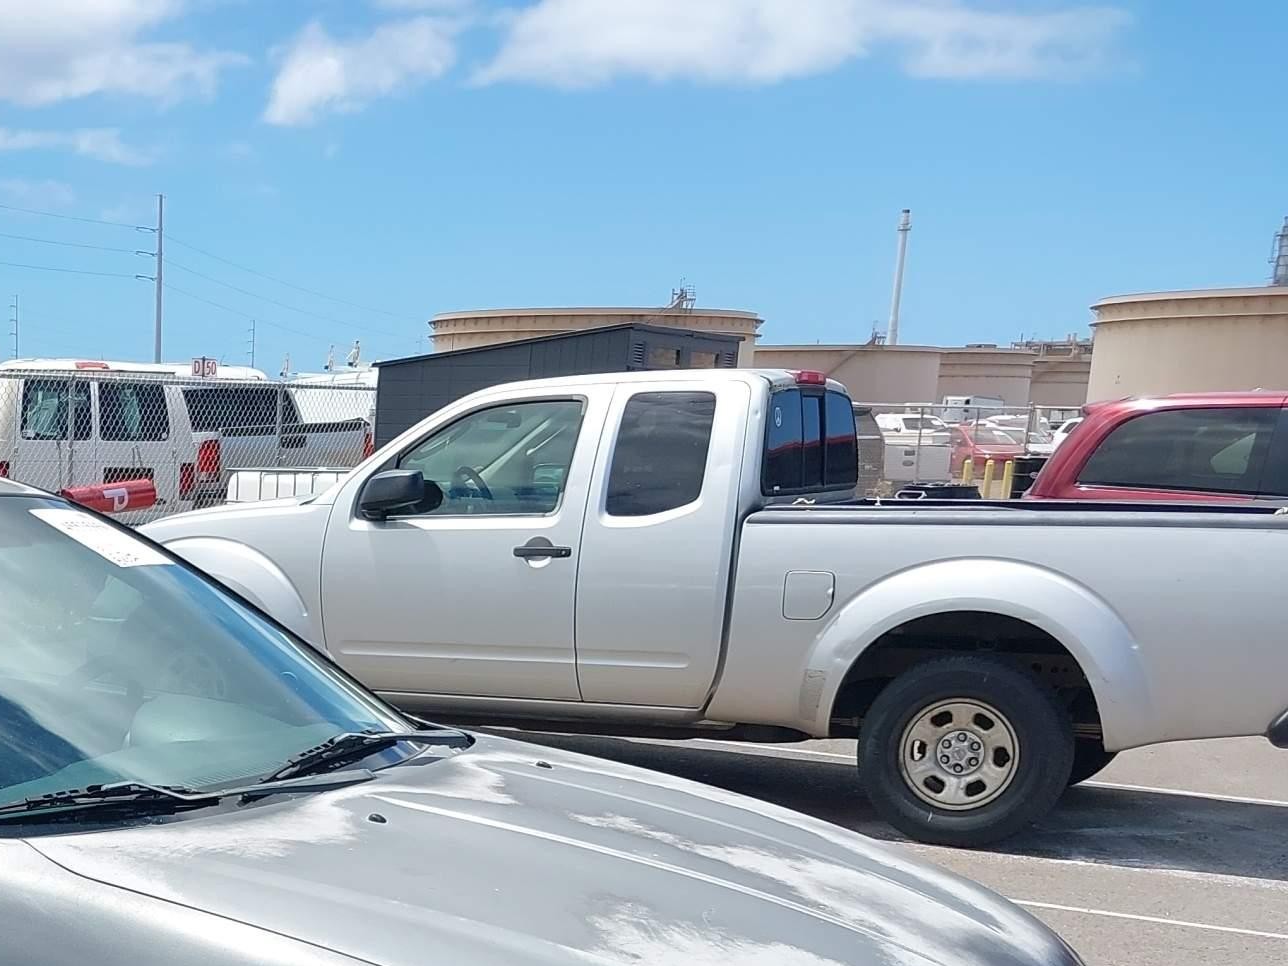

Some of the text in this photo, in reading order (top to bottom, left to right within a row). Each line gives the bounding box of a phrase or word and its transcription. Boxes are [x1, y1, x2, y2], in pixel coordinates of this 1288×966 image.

[193, 360, 217, 376] D 50
[103, 487, 129, 512] P
